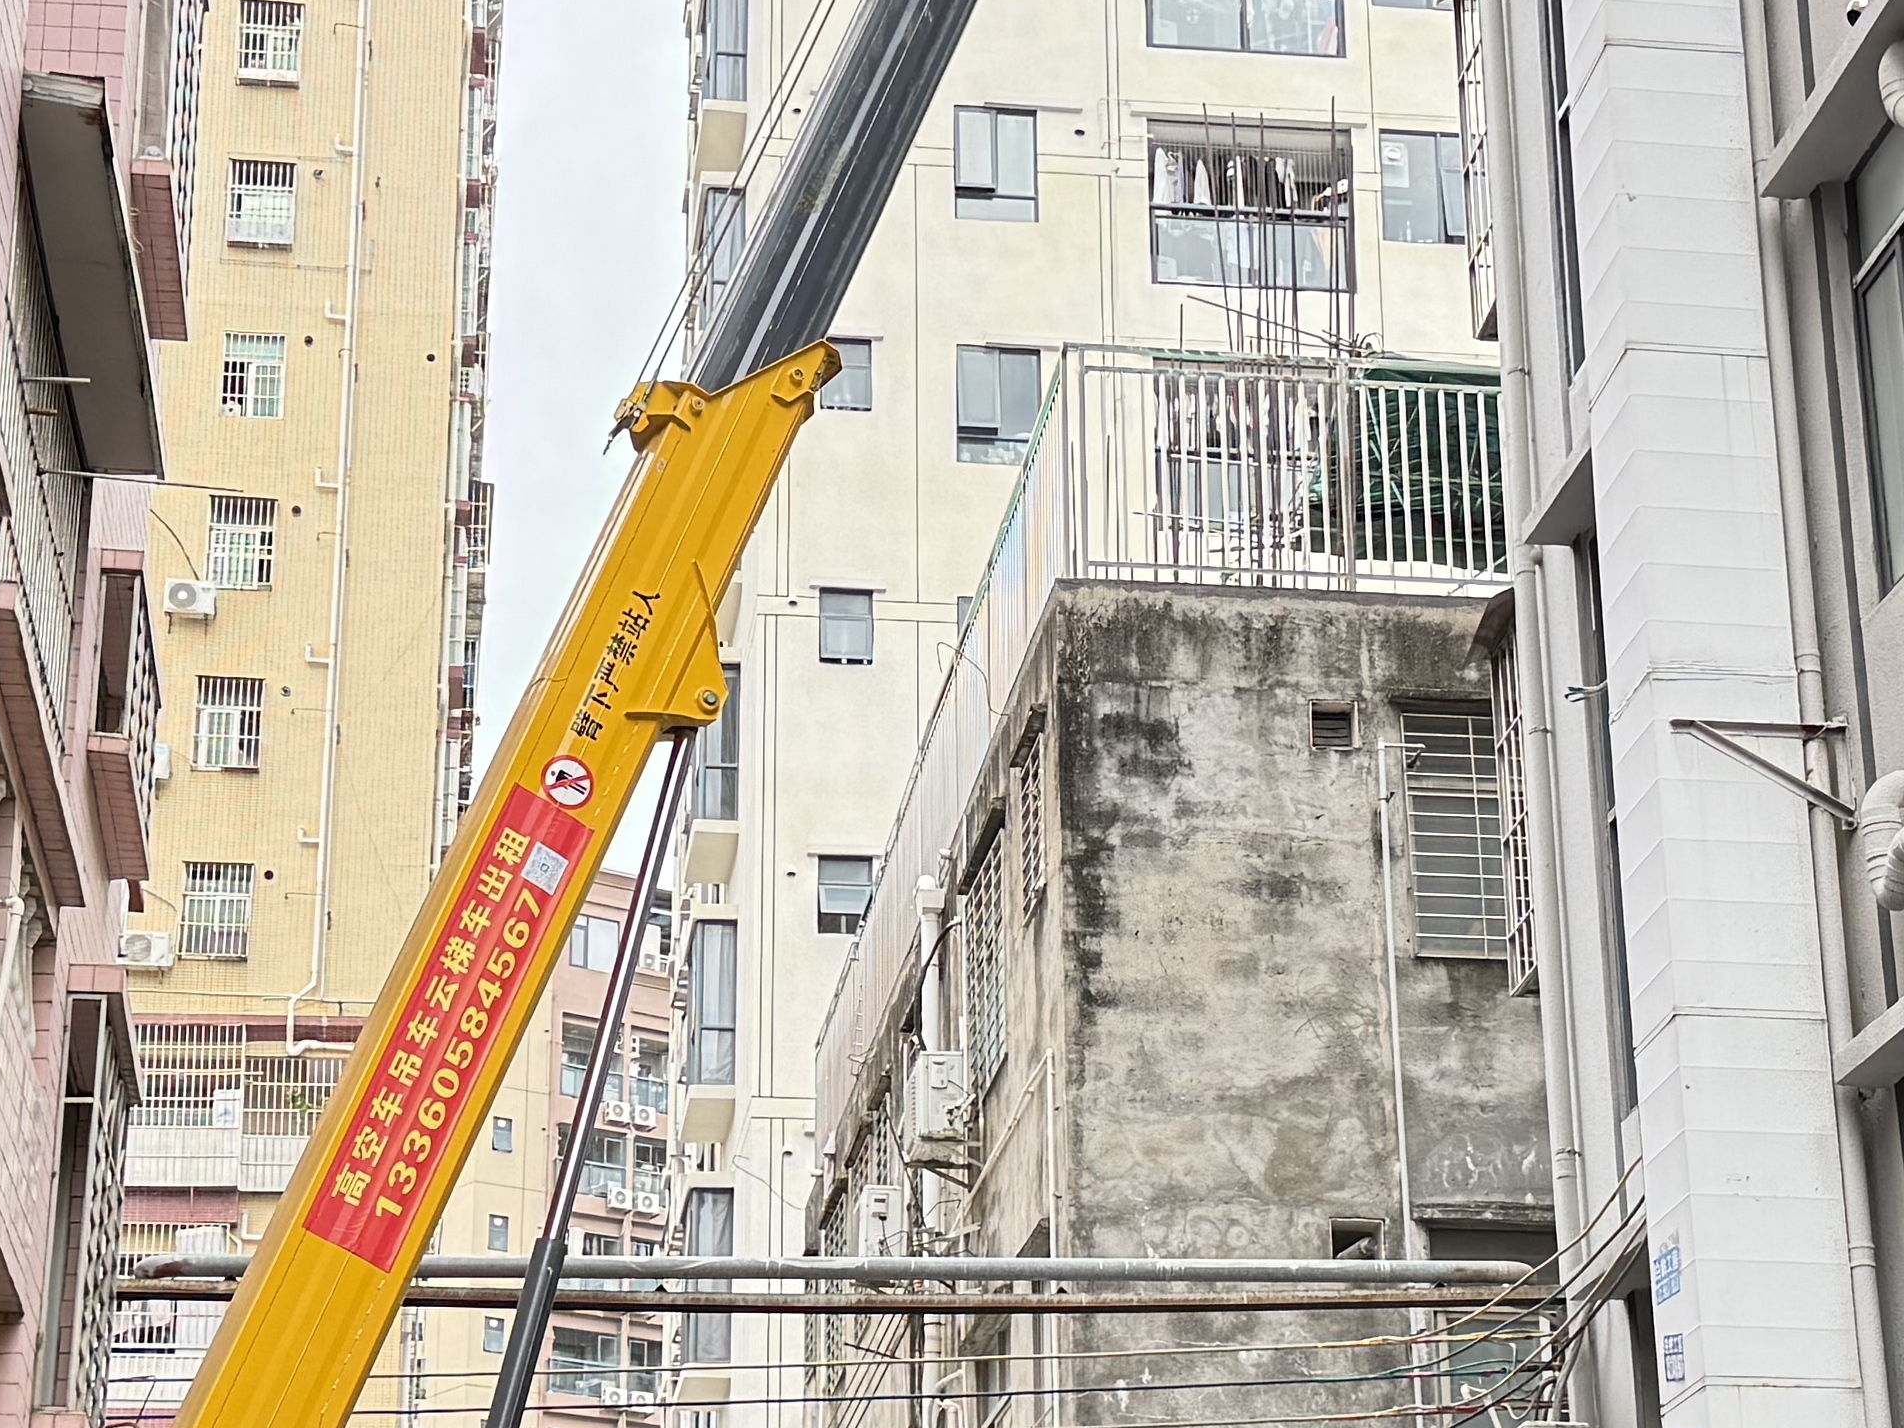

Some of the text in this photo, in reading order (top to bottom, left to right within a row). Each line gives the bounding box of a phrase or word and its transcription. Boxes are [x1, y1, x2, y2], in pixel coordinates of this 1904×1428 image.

[570, 590, 660, 741] 臂下严禁站人
[331, 826, 531, 1206] 高空车吊车云梯车出租
[375, 888, 542, 1220] 13360584567
